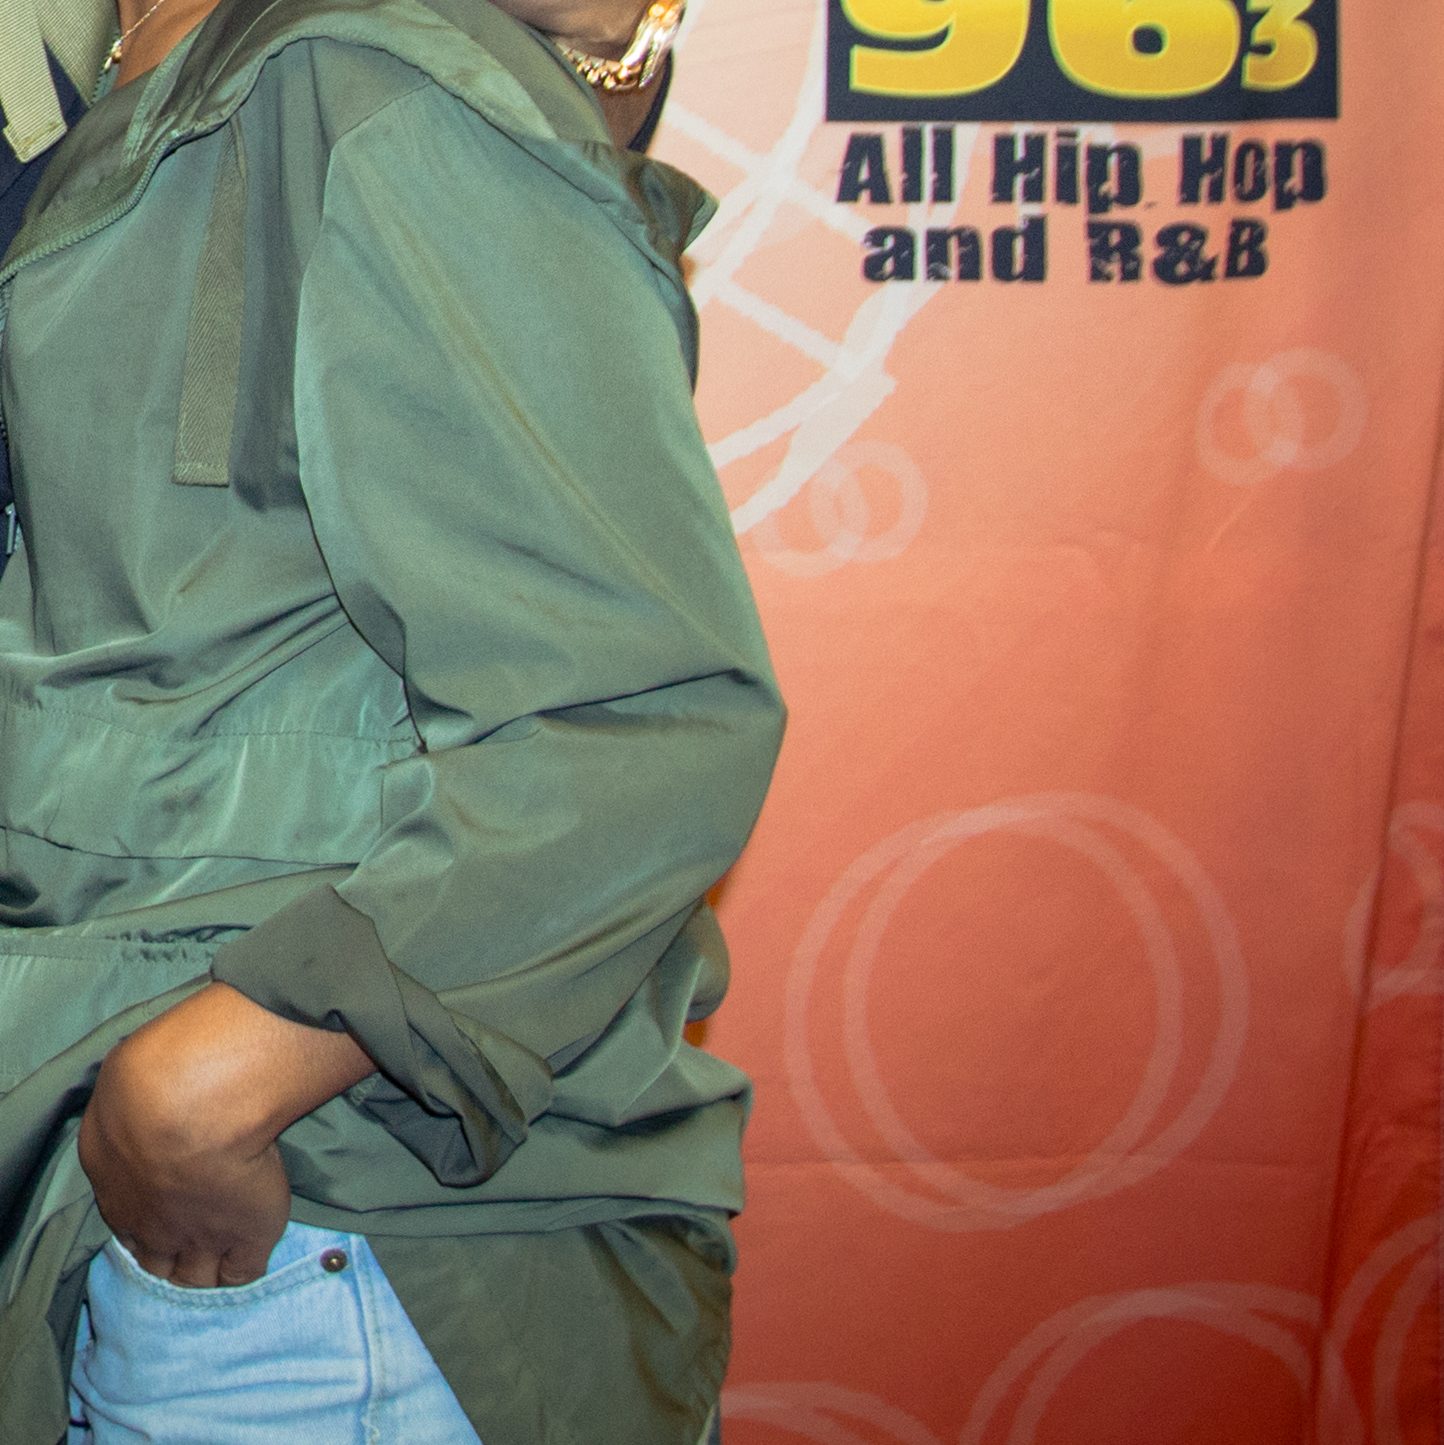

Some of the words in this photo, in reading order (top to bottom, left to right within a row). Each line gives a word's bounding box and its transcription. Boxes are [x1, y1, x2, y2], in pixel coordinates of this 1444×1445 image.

[835, 123, 956, 205] All
[989, 128, 1145, 215] Hip
[1178, 129, 1329, 214] Hop
[861, 213, 1048, 283] and
[1086, 217, 1271, 287] R&B
